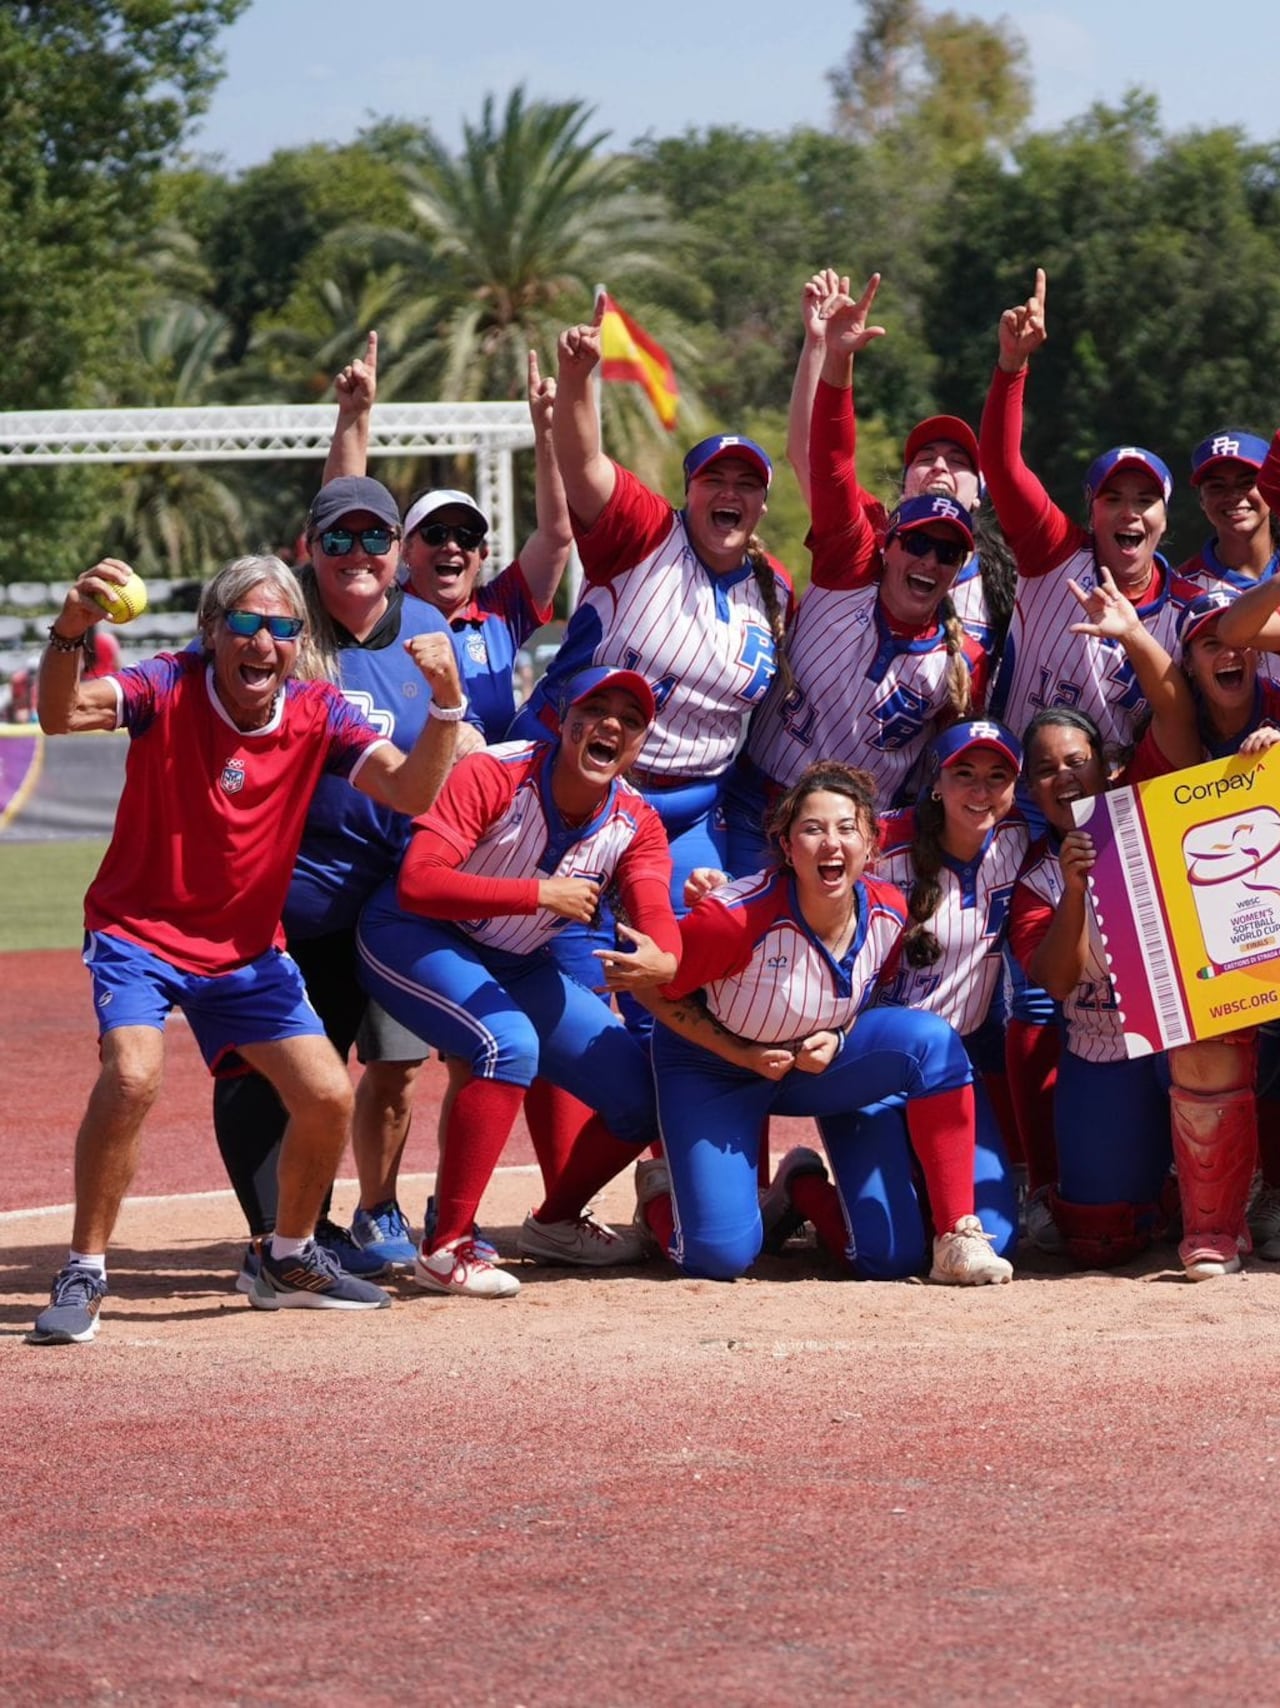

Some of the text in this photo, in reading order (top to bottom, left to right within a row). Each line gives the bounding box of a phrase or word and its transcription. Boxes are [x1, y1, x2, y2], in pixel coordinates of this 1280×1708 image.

[1212, 436, 1239, 455] PR
[932, 497, 960, 519] PR
[865, 679, 934, 751] PR
[1174, 770, 1256, 805] Corpay
[1236, 896, 1261, 909] WBSC
[1230, 907, 1274, 926] WOMEN'S
[1232, 917, 1276, 935] SOFTBALL
[1230, 923, 1280, 944] WORLD CUP
[1209, 989, 1278, 1018] WBSC.ORG
